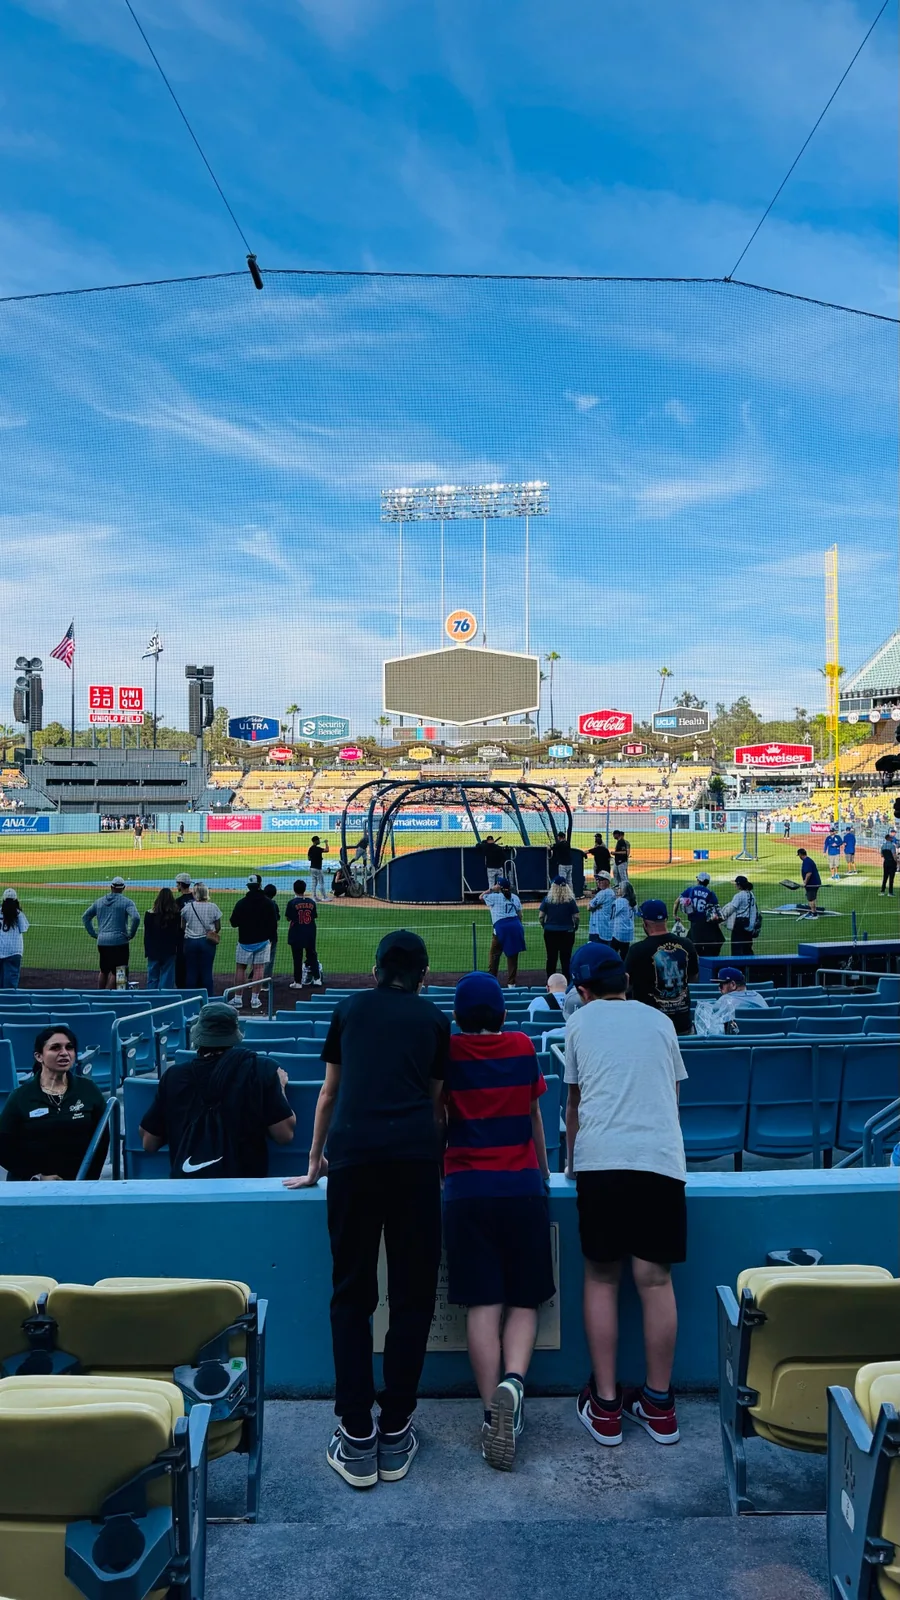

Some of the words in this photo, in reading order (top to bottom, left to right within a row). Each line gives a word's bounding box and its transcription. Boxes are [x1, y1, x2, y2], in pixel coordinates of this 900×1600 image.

[453, 618, 470, 632] 76
[93, 688, 110, 697] ユニ
[122, 690, 138, 698] UNI
[92, 698, 110, 706] クロ
[122, 699, 140, 708] QLO
[318, 721, 346, 730] Security
[582, 716, 627, 731] Coca-Cola
[679, 718, 704, 726] Health
[552, 747, 569, 755] TEL
[742, 753, 805, 763] Budweiser
[2, 818, 25, 827] ANA
[271, 816, 314, 827] Spectrum
[393, 818, 439, 827] smartwater
[693, 890, 708, 898] NOMO
[504, 904, 517, 913] 17
[693, 898, 706, 912] 16
